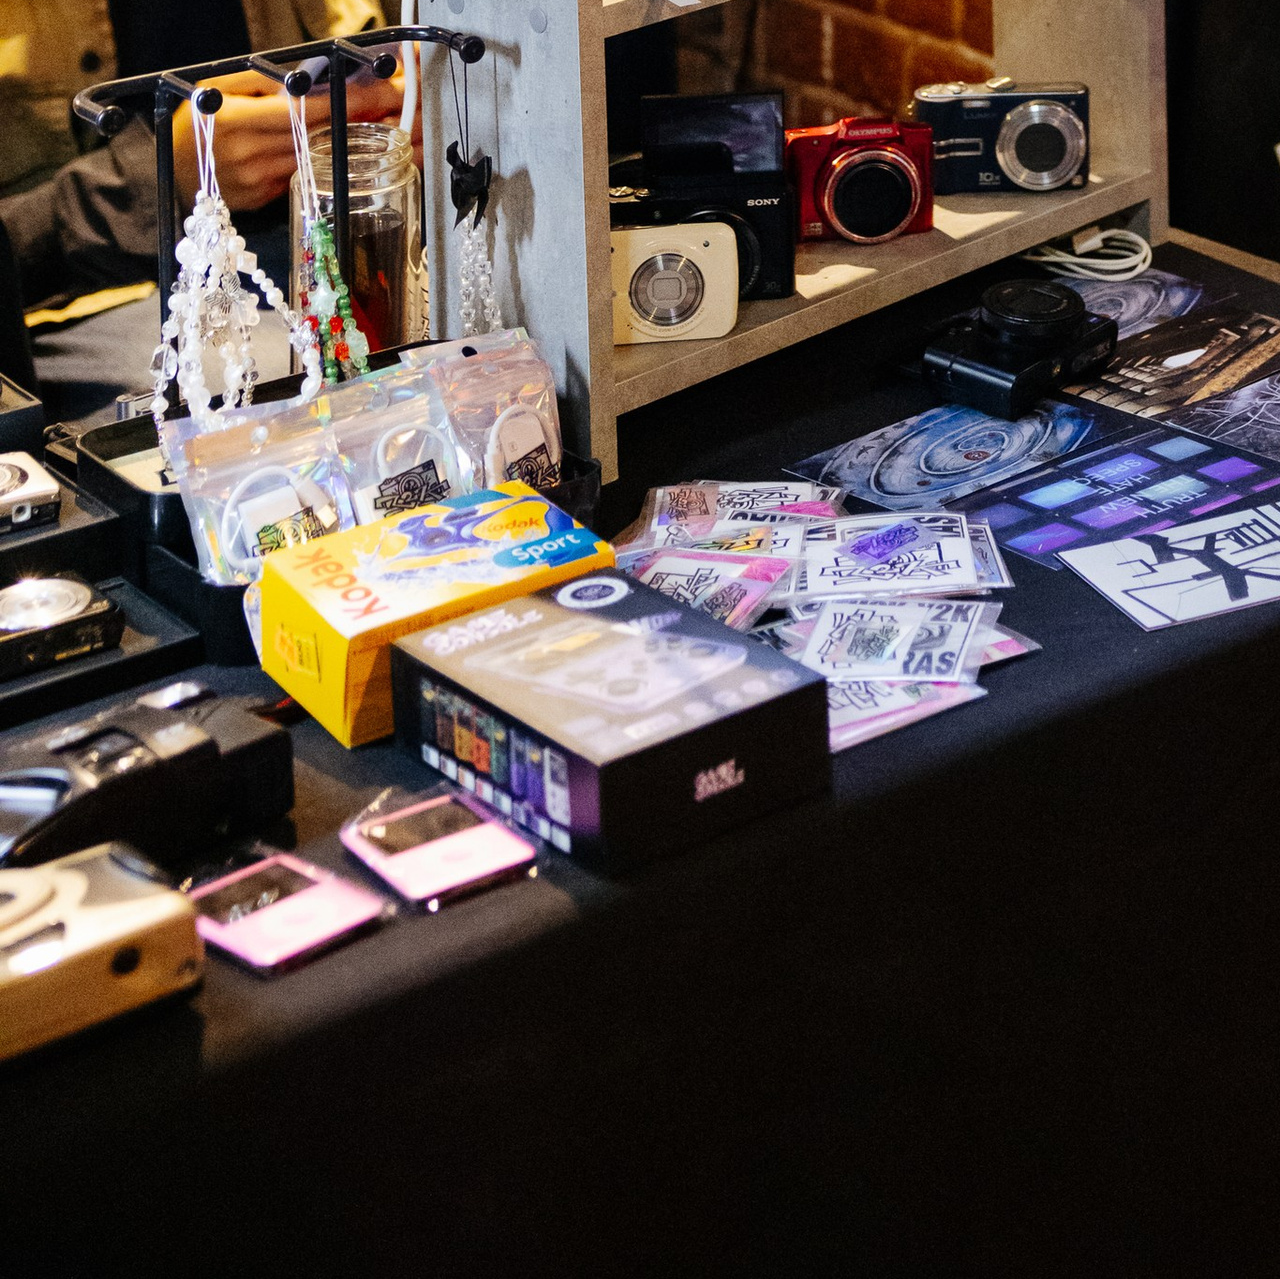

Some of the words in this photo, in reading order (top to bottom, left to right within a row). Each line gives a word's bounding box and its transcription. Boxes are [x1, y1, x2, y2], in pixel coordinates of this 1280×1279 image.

[848, 126, 893, 136] OLYMPUS
[747, 198, 780, 206] SONY
[1096, 472, 1151, 497] HATE
[1153, 474, 1194, 496] THE
[1099, 491, 1153, 514] NEW
[1134, 492, 1208, 518] TRUTH
[482, 516, 541, 533] Kodak
[512, 533, 581, 561] Sport
[293, 547, 390, 620] Kodak
